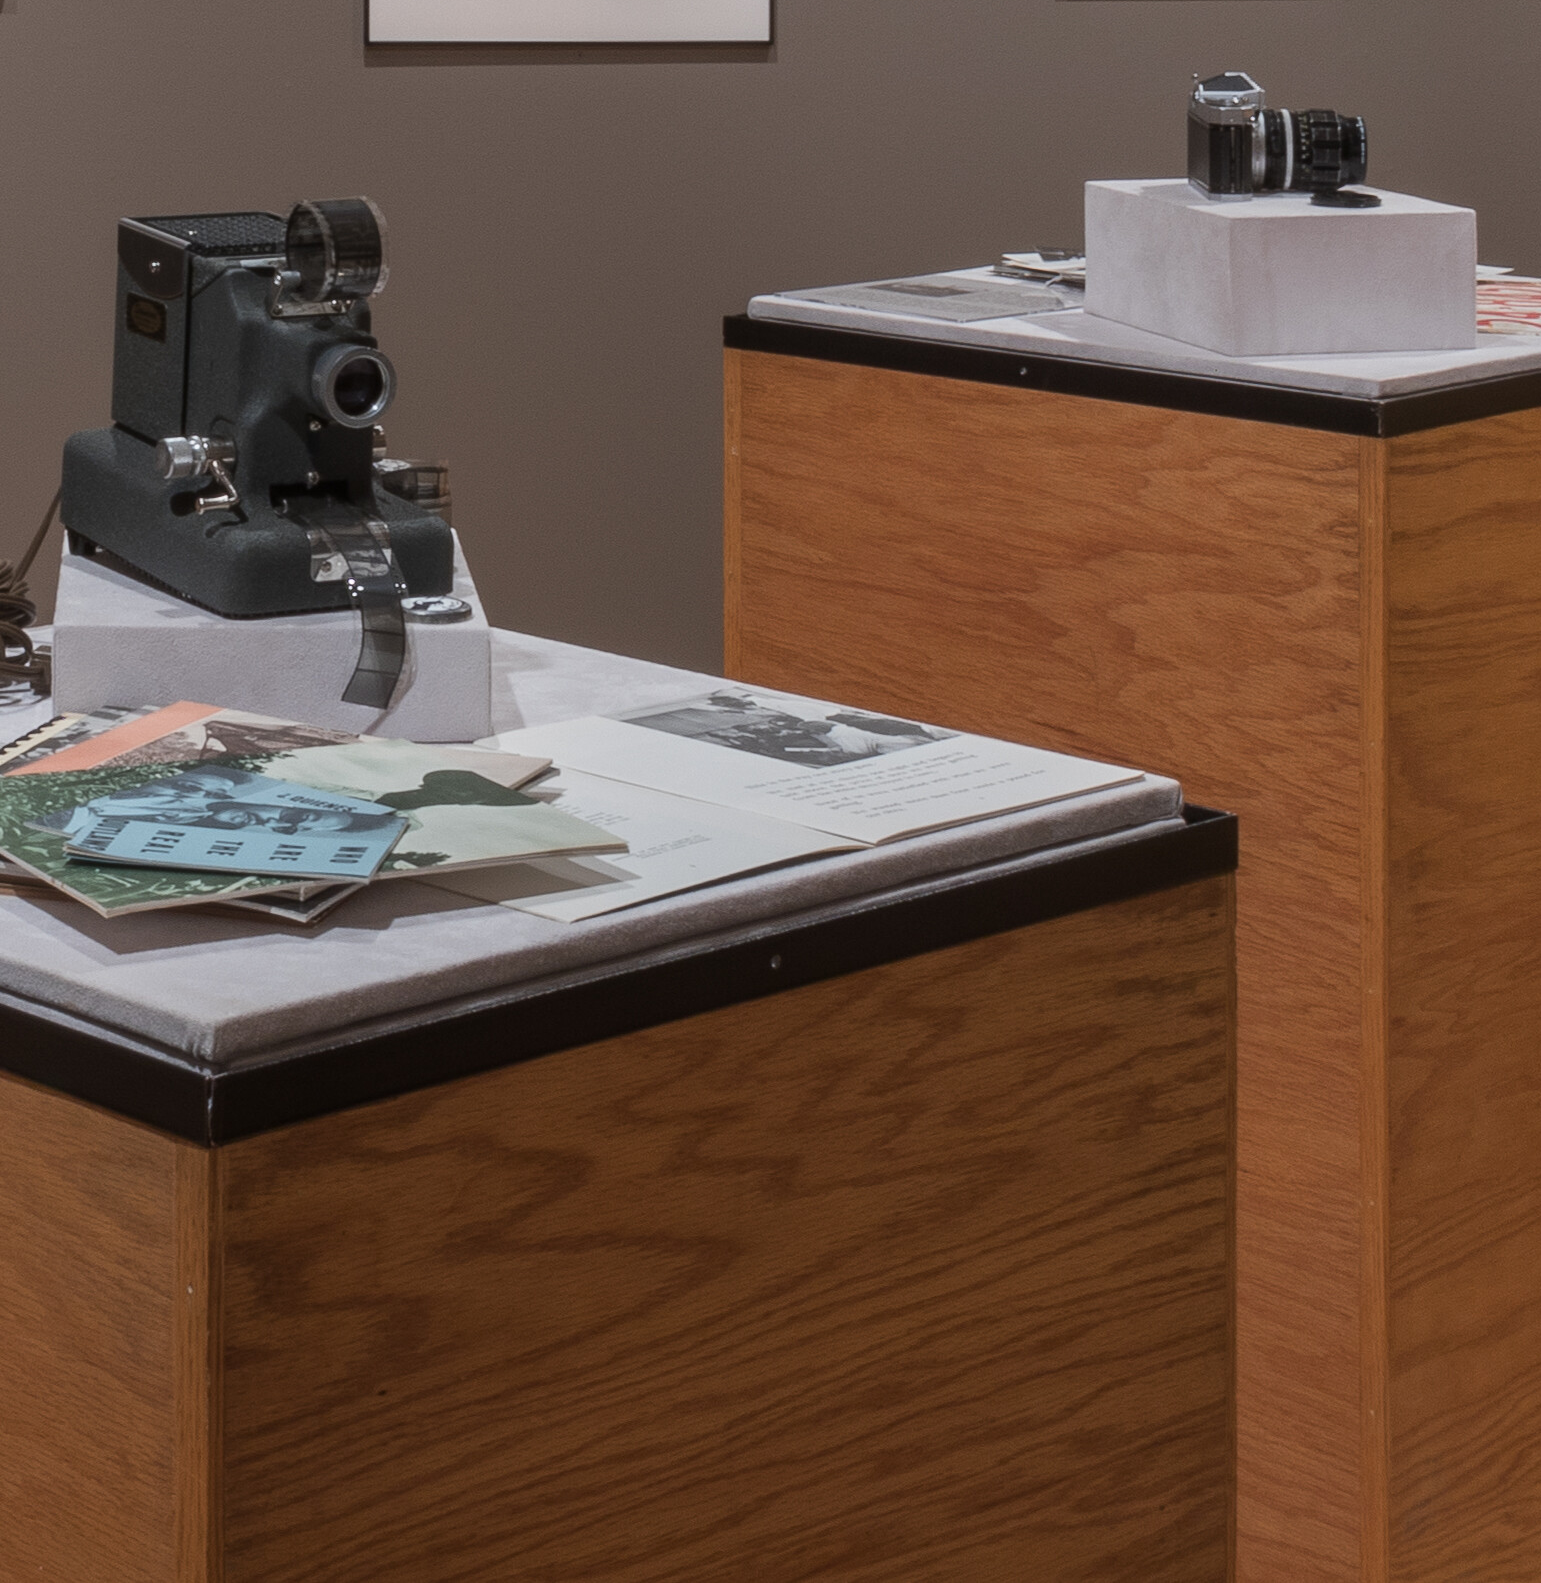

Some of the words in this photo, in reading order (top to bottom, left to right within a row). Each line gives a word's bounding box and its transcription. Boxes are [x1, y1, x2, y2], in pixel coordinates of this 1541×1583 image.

[139, 828, 186, 855] REAL
[205, 839, 245, 858] THE
[268, 842, 310, 862] ARE
[329, 845, 369, 864] WHO
